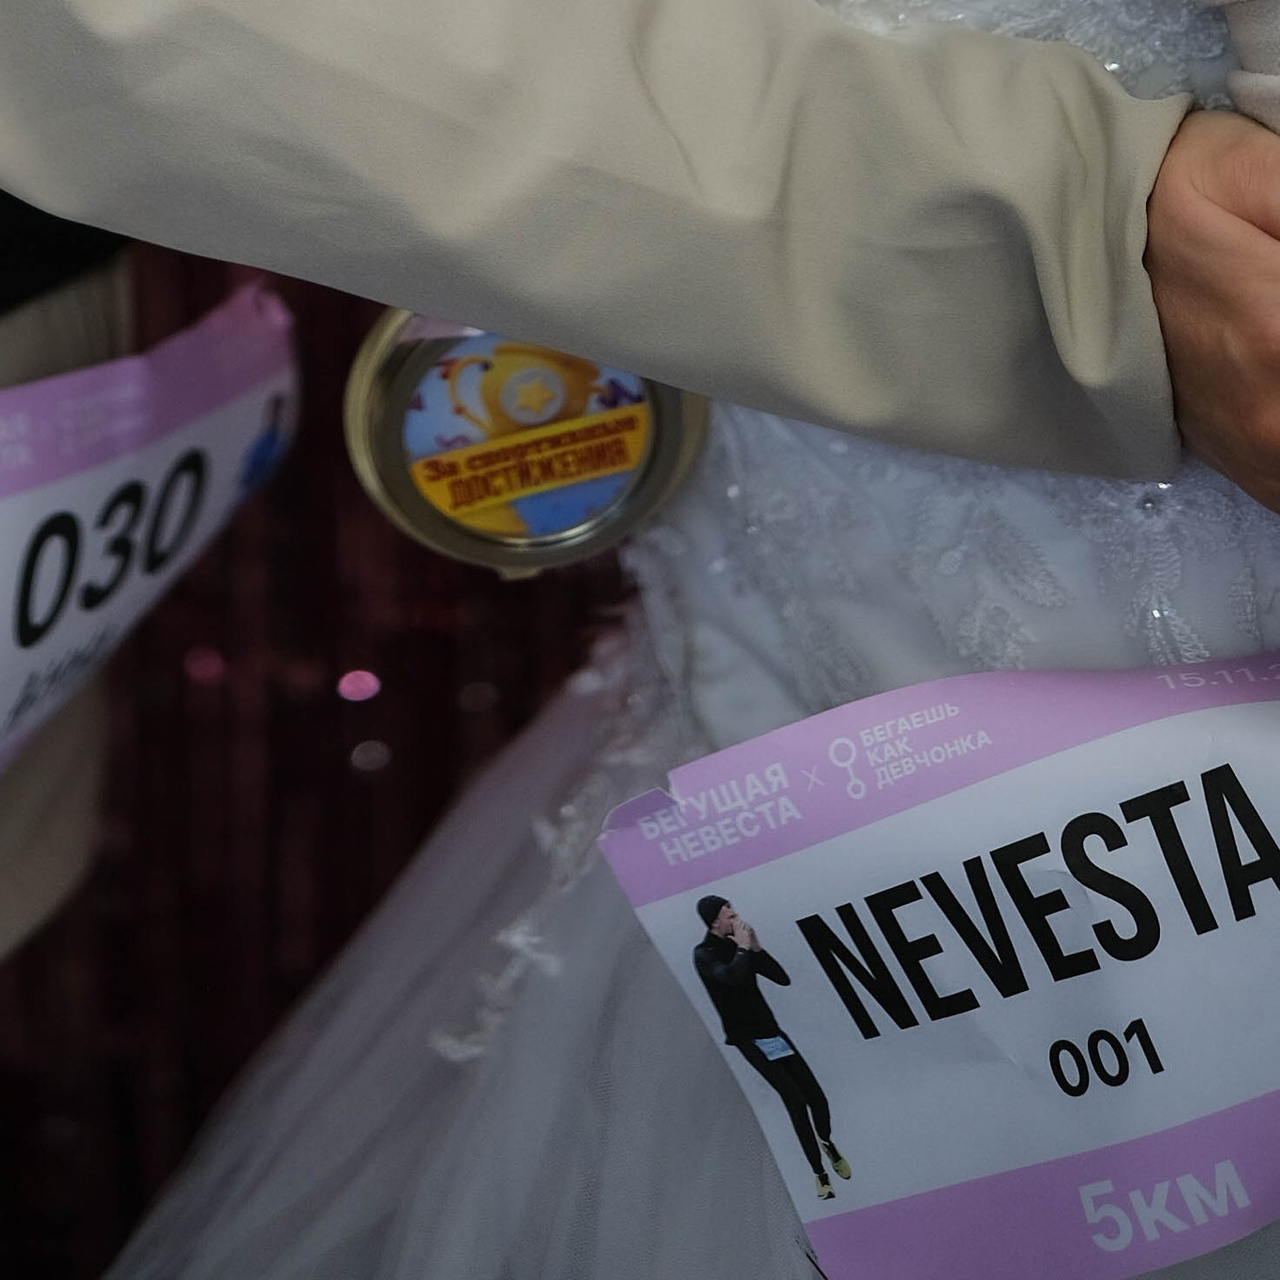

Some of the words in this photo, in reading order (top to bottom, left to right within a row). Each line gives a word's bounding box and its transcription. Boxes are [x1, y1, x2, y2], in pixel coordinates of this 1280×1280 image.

[14, 448, 209, 649] 030
[859, 703, 960, 747] БЕГАЕШЬ
[866, 737, 913, 766] КАК
[875, 730, 992, 790] ДЕВЧОНКА
[638, 762, 790, 840] БЕГУЩАЯ
[660, 795, 803, 866] НЕВЕСТА
[796, 763, 1280, 1040] NEVESTA
[1048, 1017, 1164, 1097] 001
